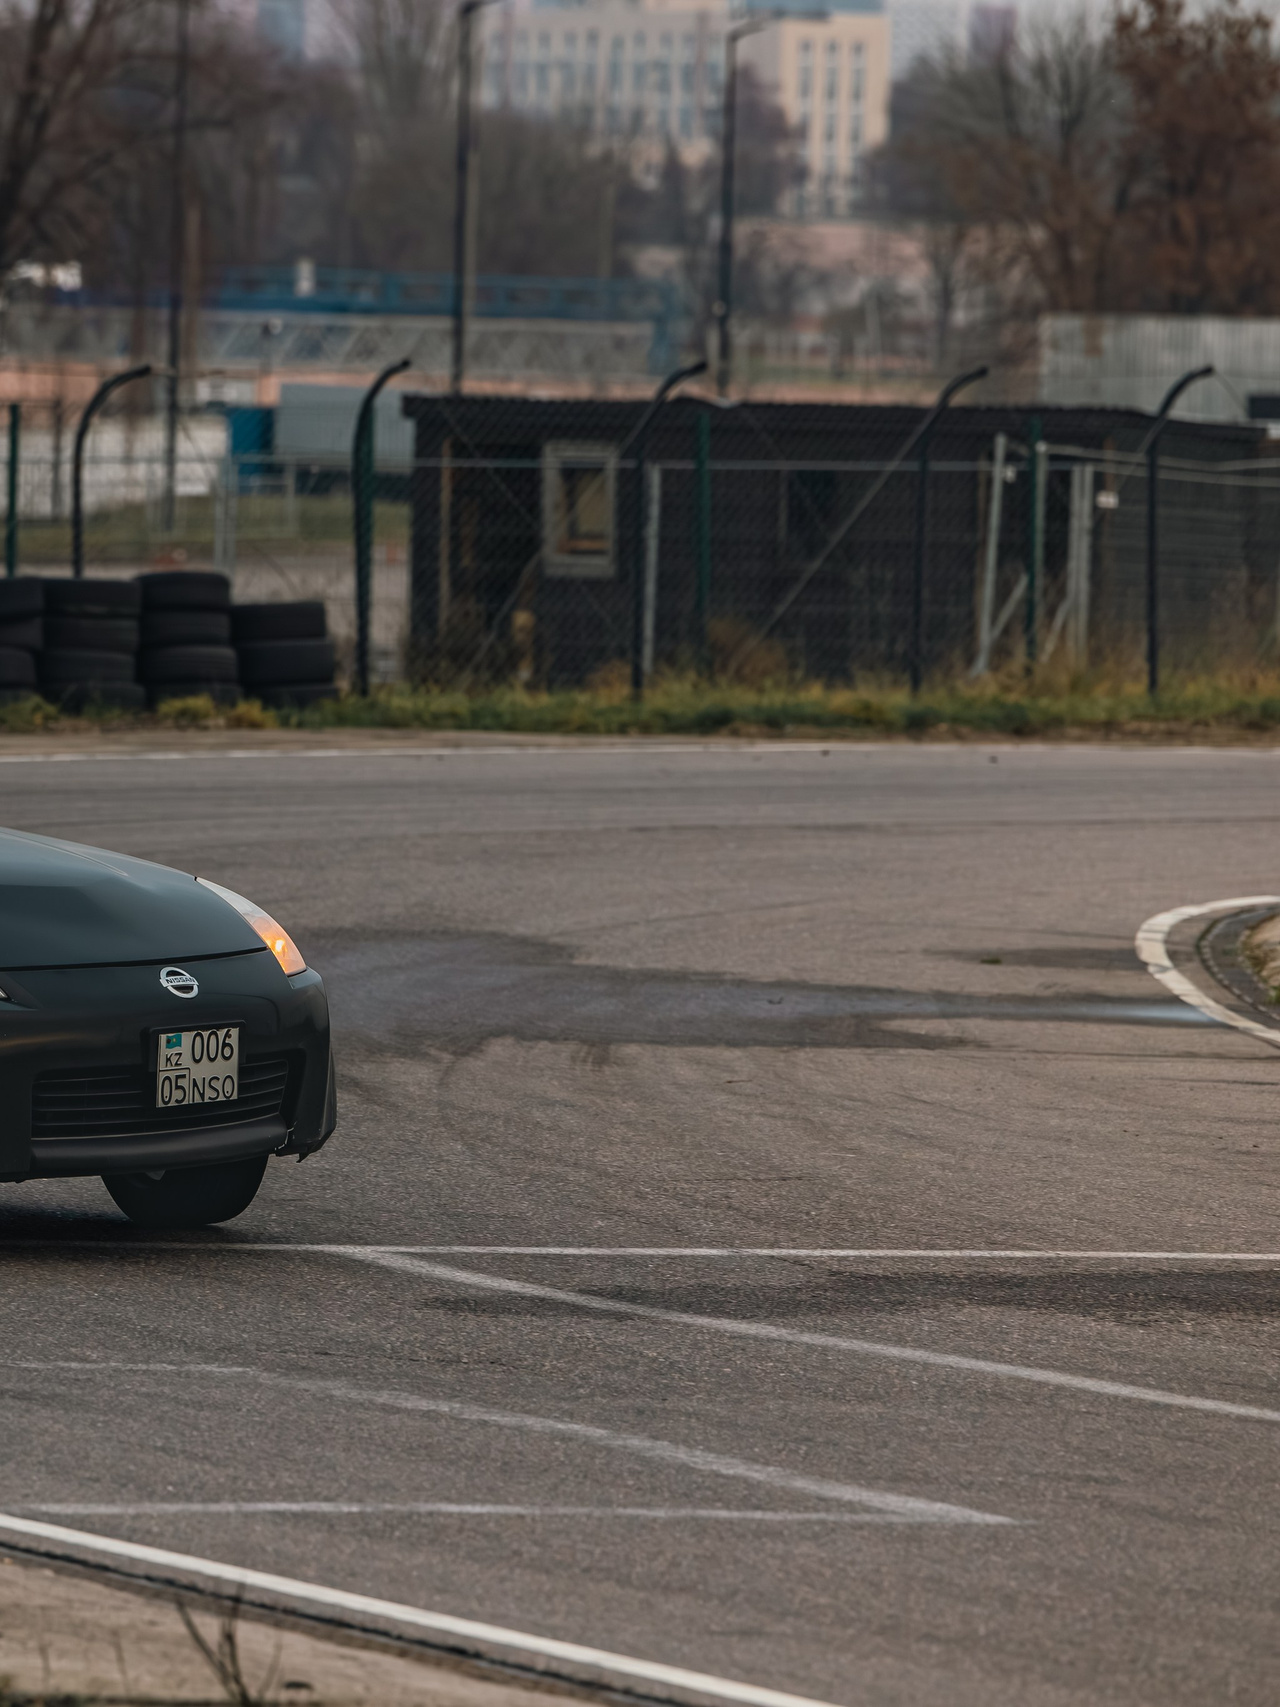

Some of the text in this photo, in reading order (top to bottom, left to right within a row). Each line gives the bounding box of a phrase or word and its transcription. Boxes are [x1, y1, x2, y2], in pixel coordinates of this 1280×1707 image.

[165, 1053, 182, 1067] KZ
[192, 1029, 234, 1063] 006
[161, 1074, 235, 1105] 05 NSO
